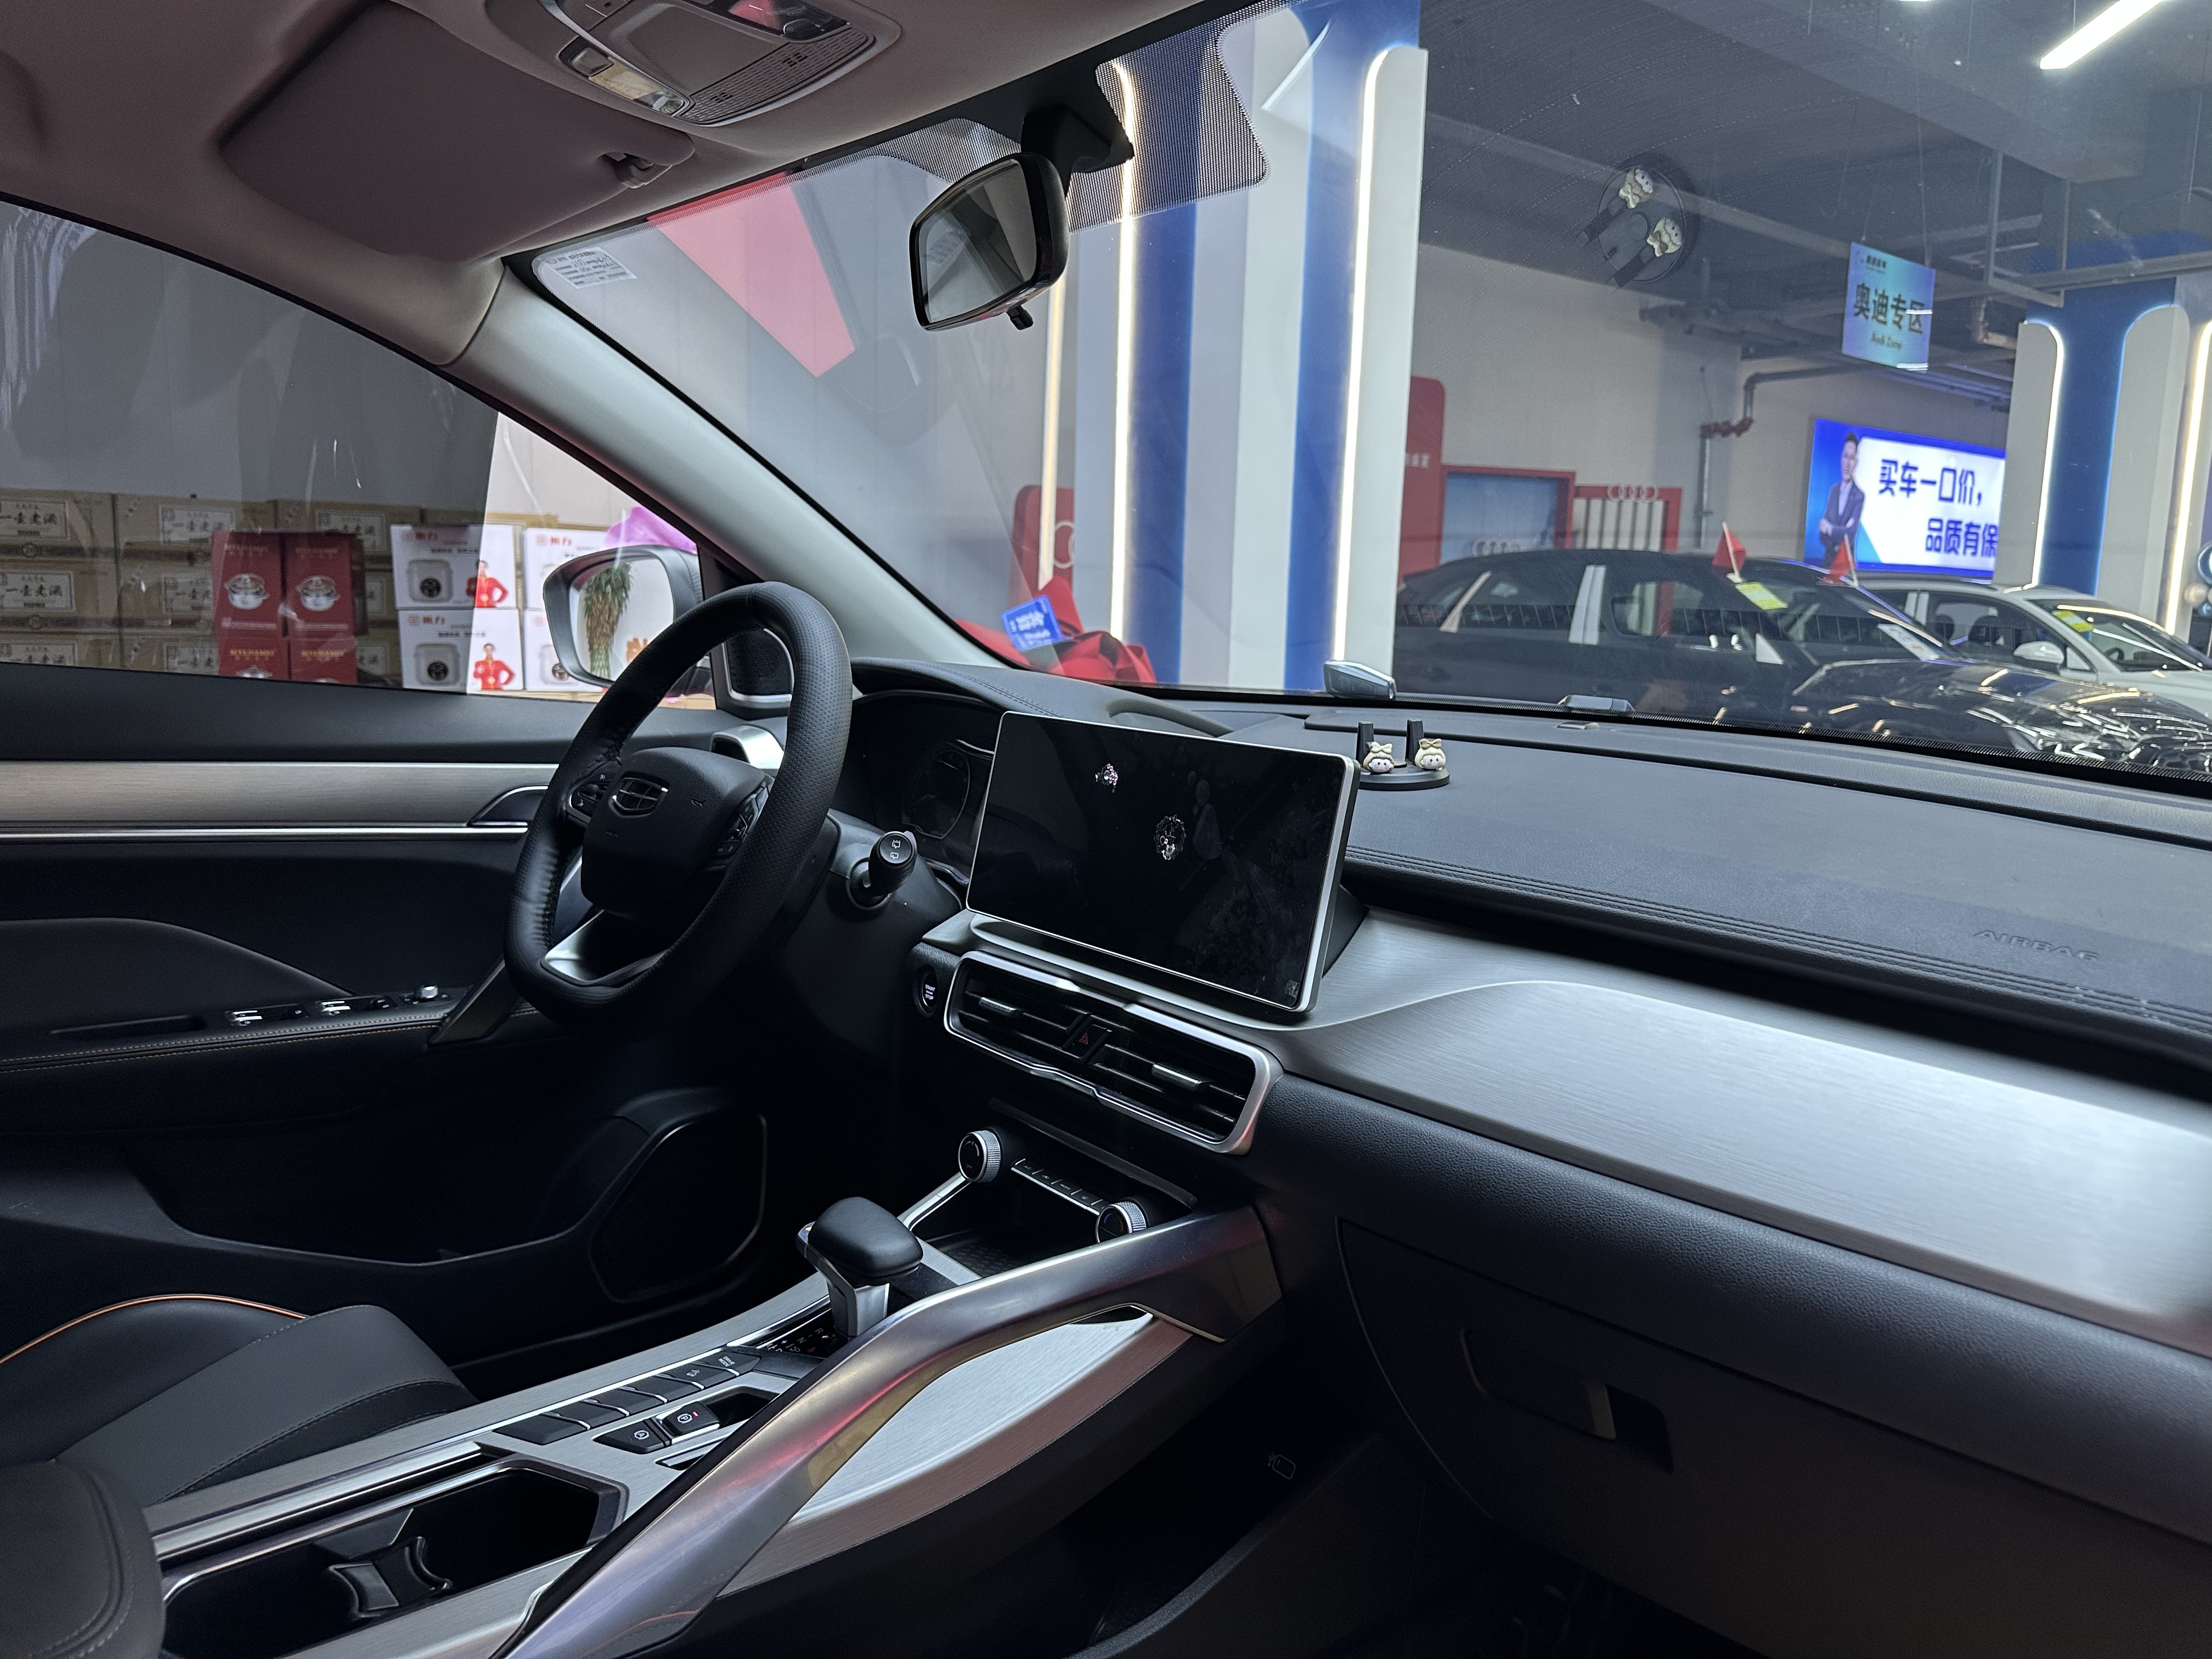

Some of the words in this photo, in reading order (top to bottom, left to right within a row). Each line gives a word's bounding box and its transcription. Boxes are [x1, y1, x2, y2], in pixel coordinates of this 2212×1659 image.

[1854, 283, 1925, 334] 奥迪专区
[1925, 518, 1999, 557] 品质有保
[1973, 929, 2100, 961] AIRBAG
